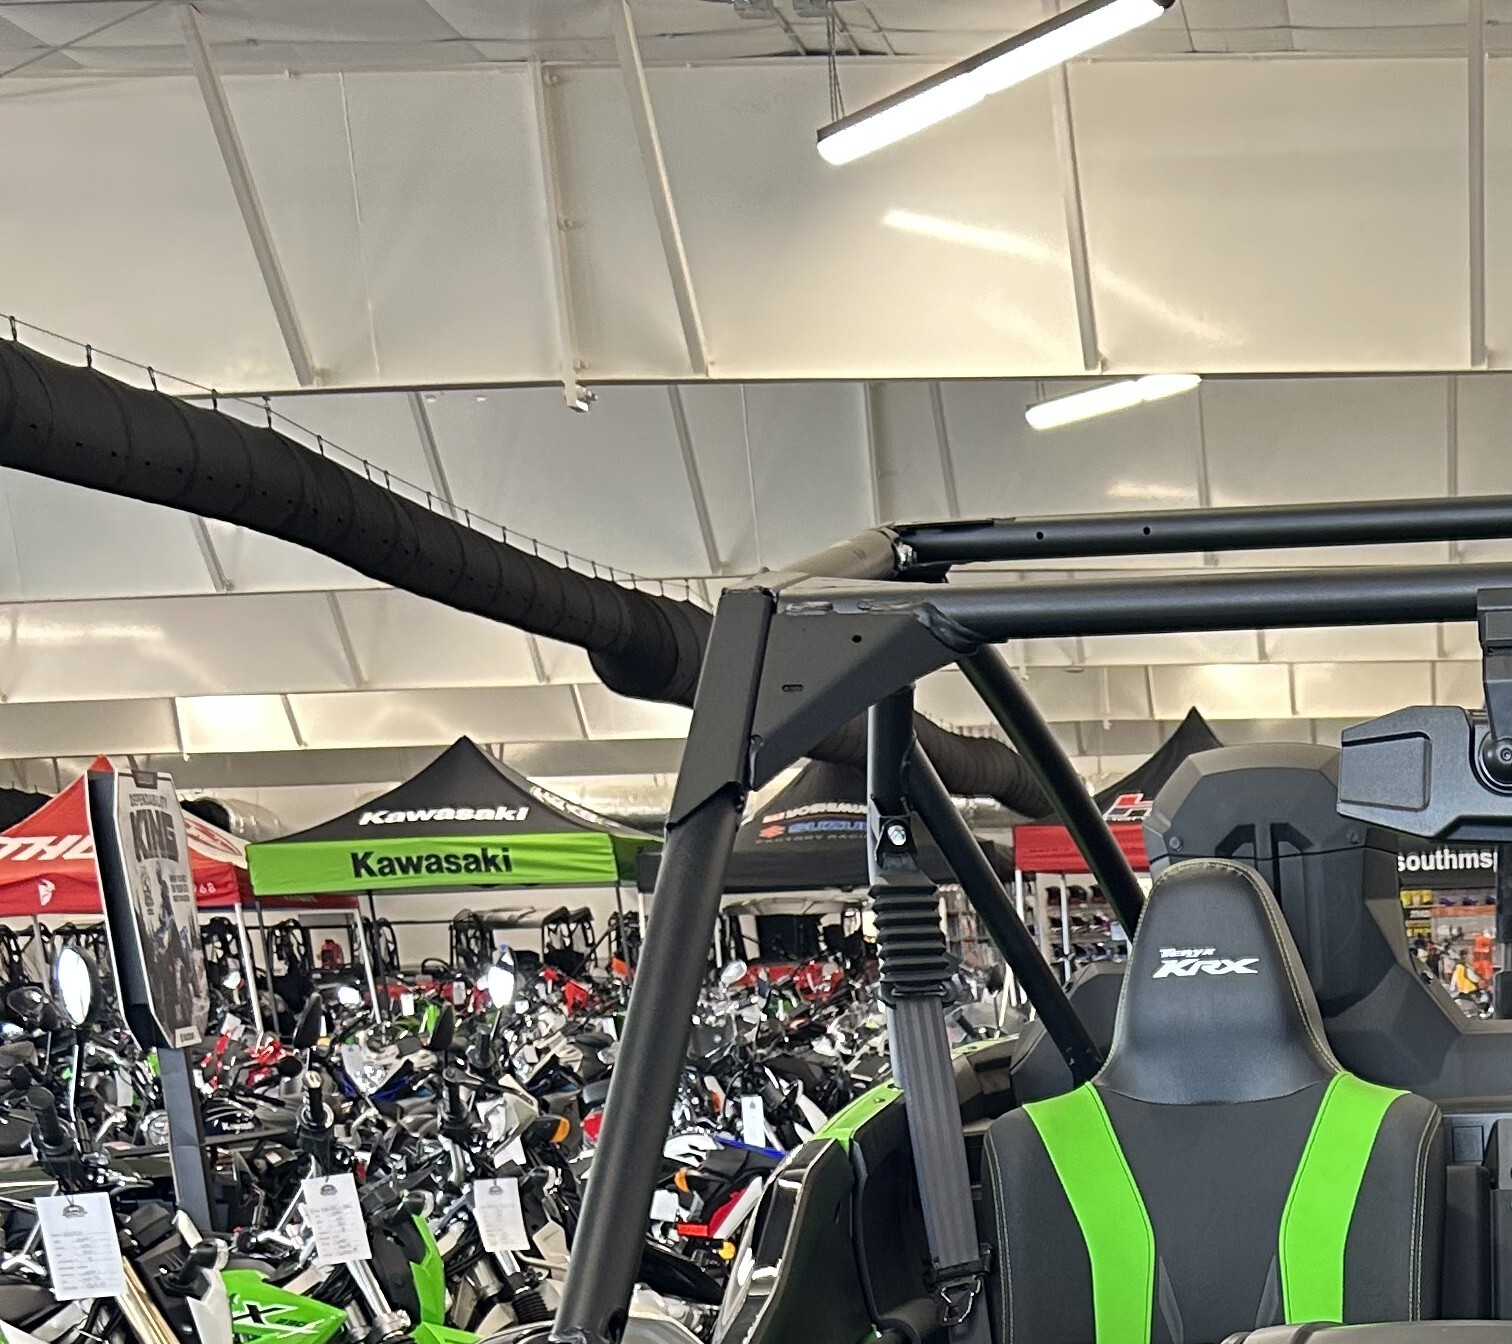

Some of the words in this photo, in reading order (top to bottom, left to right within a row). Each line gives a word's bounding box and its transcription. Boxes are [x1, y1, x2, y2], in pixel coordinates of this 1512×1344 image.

[358, 805, 531, 826] Kawasaki
[129, 809, 179, 863] KING
[350, 847, 513, 879] Kawasaki
[1152, 957, 1260, 978] KRX
